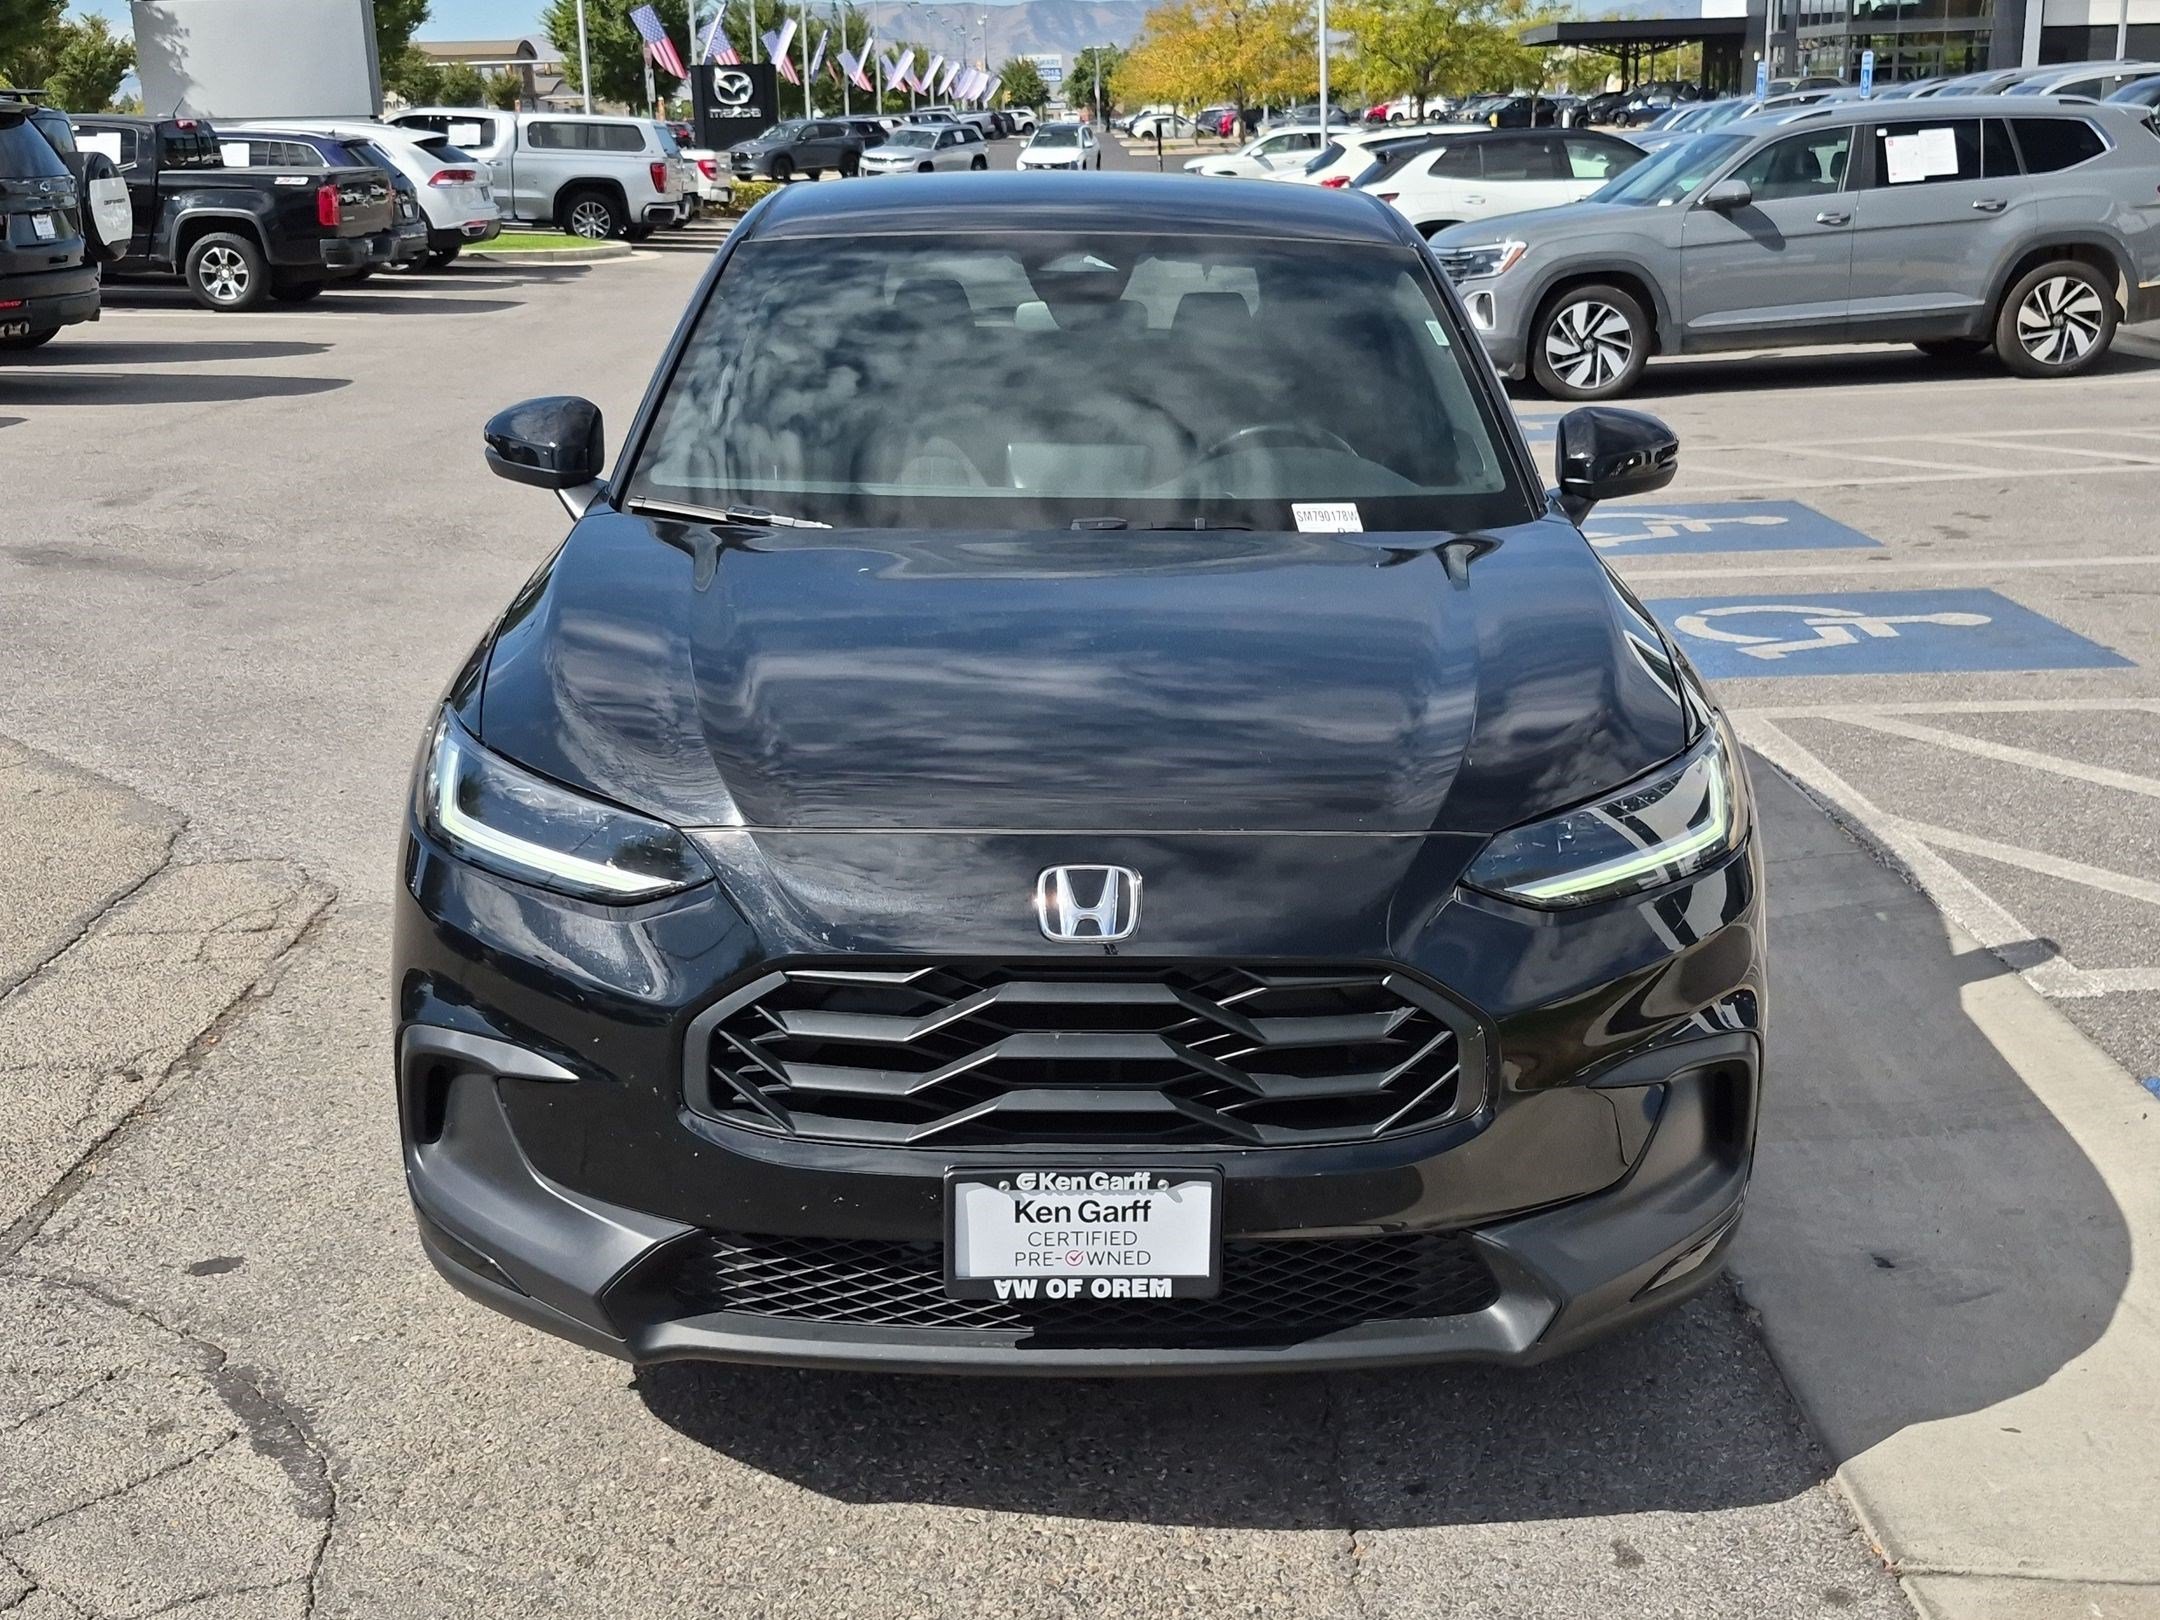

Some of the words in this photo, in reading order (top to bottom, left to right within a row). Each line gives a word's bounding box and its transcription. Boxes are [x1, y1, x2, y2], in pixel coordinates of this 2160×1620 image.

[1039, 1172, 1087, 1191] Ken
[1089, 1171, 1151, 1191] Garff
[1014, 1200, 1071, 1223] Ken
[1078, 1199, 1152, 1223] Garff
[1027, 1230, 1138, 1247] CERTIFIED
[1045, 1279, 1084, 1299] OF
[1090, 1278, 1173, 1298] OREM
